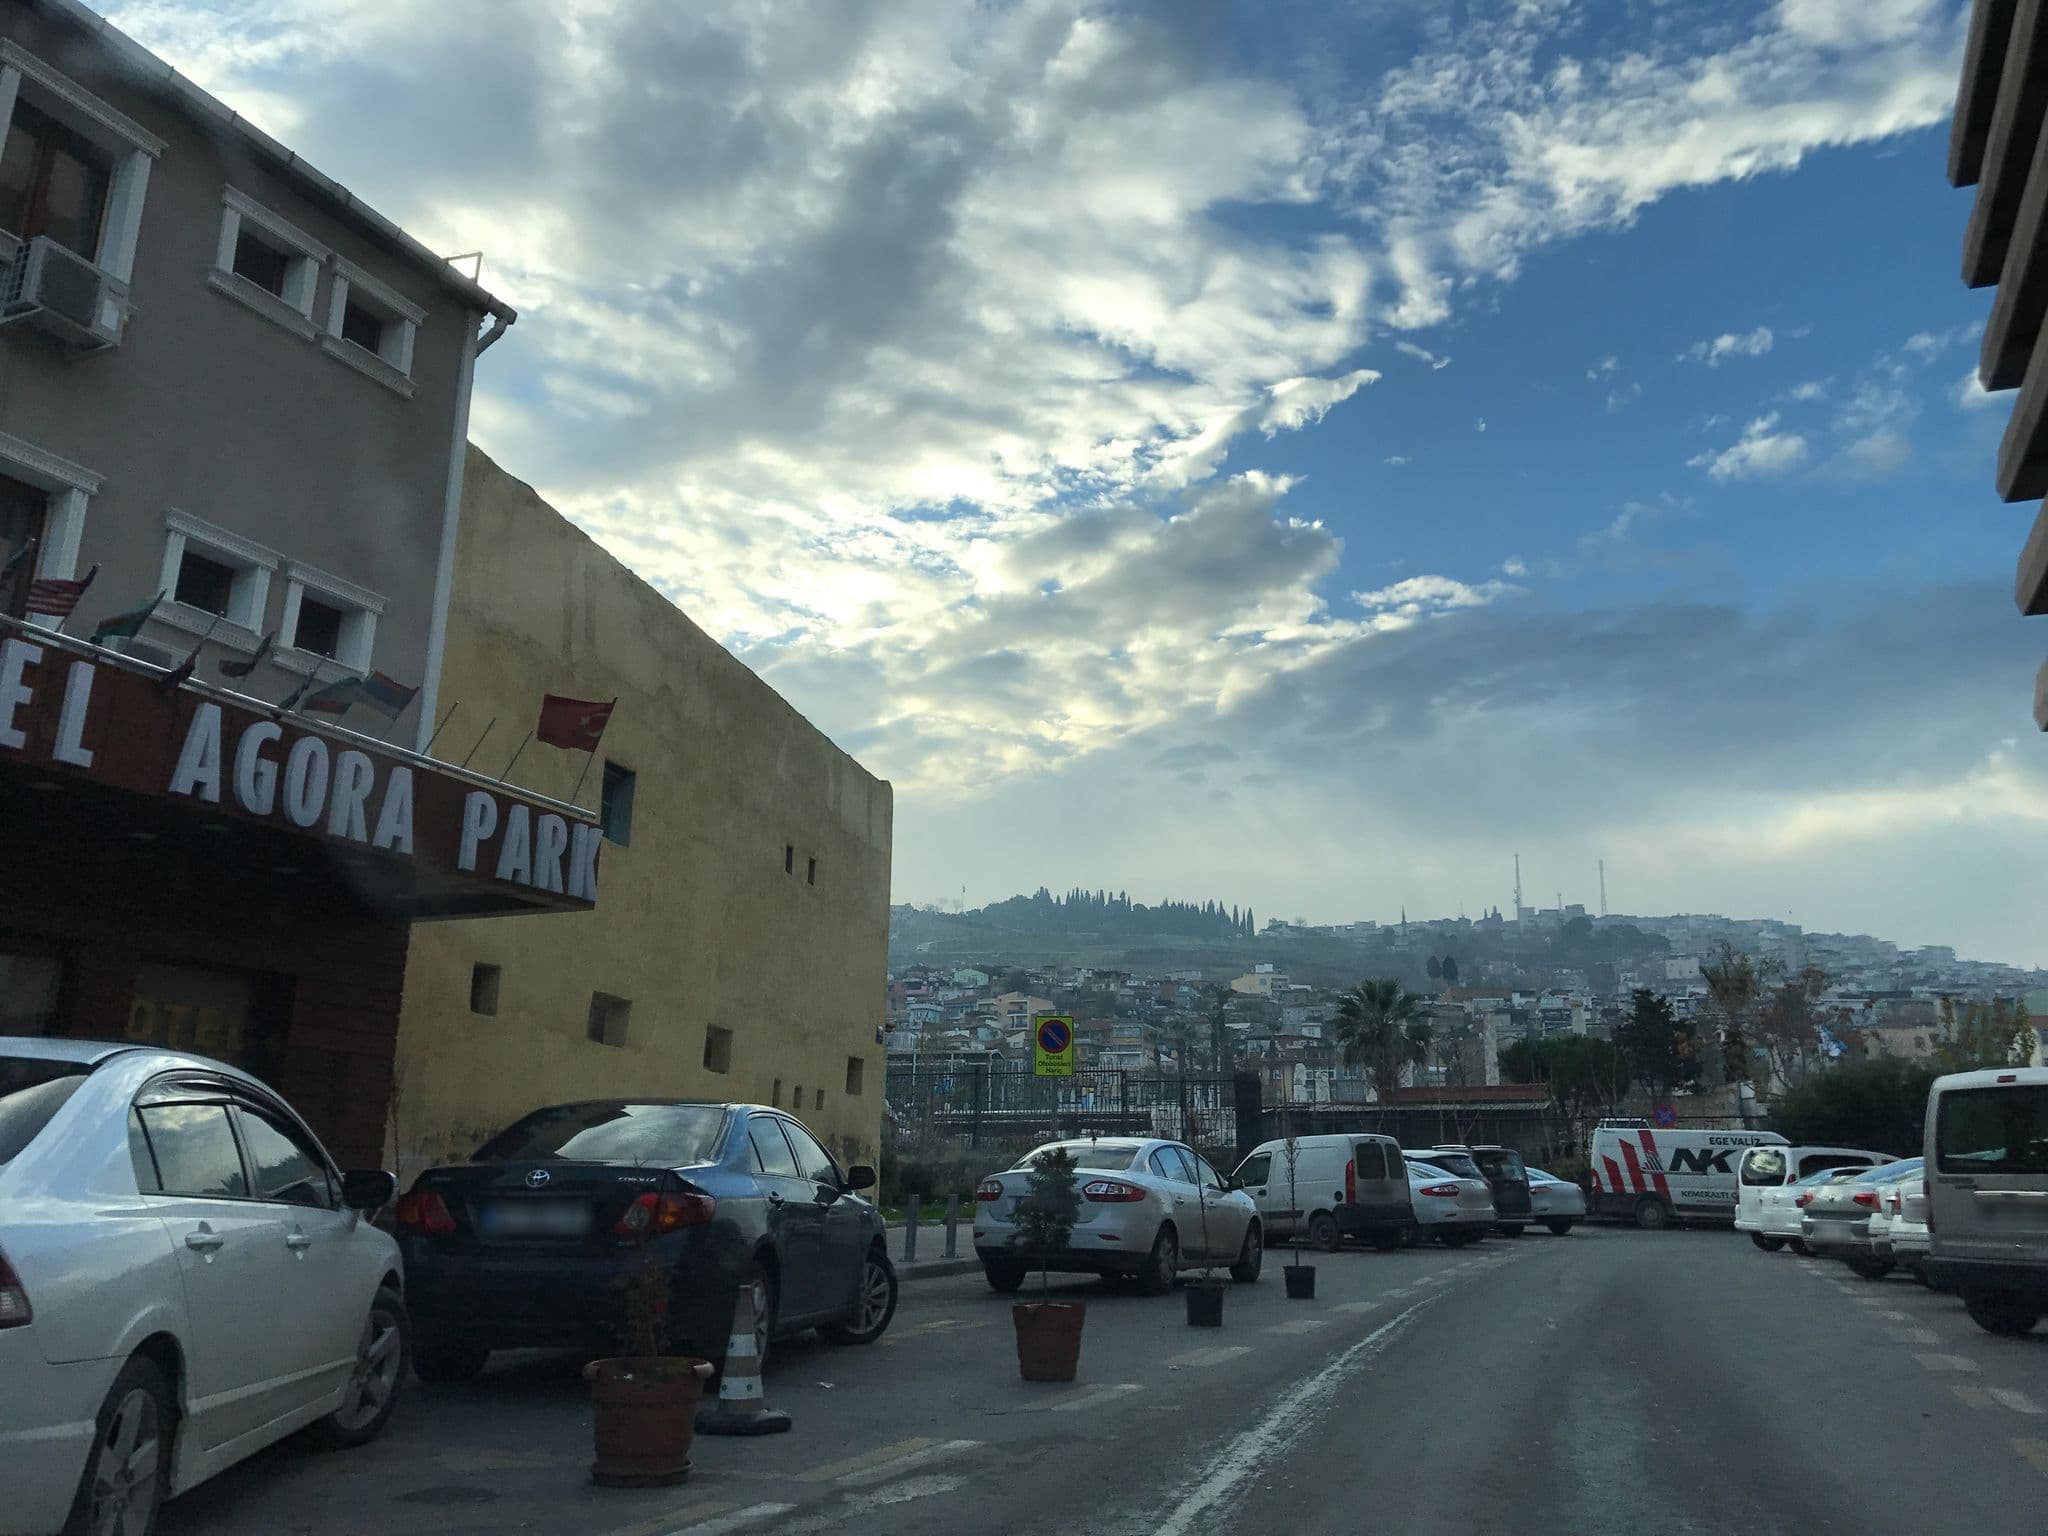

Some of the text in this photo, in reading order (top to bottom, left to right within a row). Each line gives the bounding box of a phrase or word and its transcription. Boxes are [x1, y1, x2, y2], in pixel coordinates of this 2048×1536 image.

[168, 703, 415, 855] AGORA
[457, 790, 604, 901] PARK
[1709, 1136, 1729, 1146] EGE
[1669, 1148, 1737, 1174] NK
[1681, 1190, 1729, 1199] KEMERALTI
